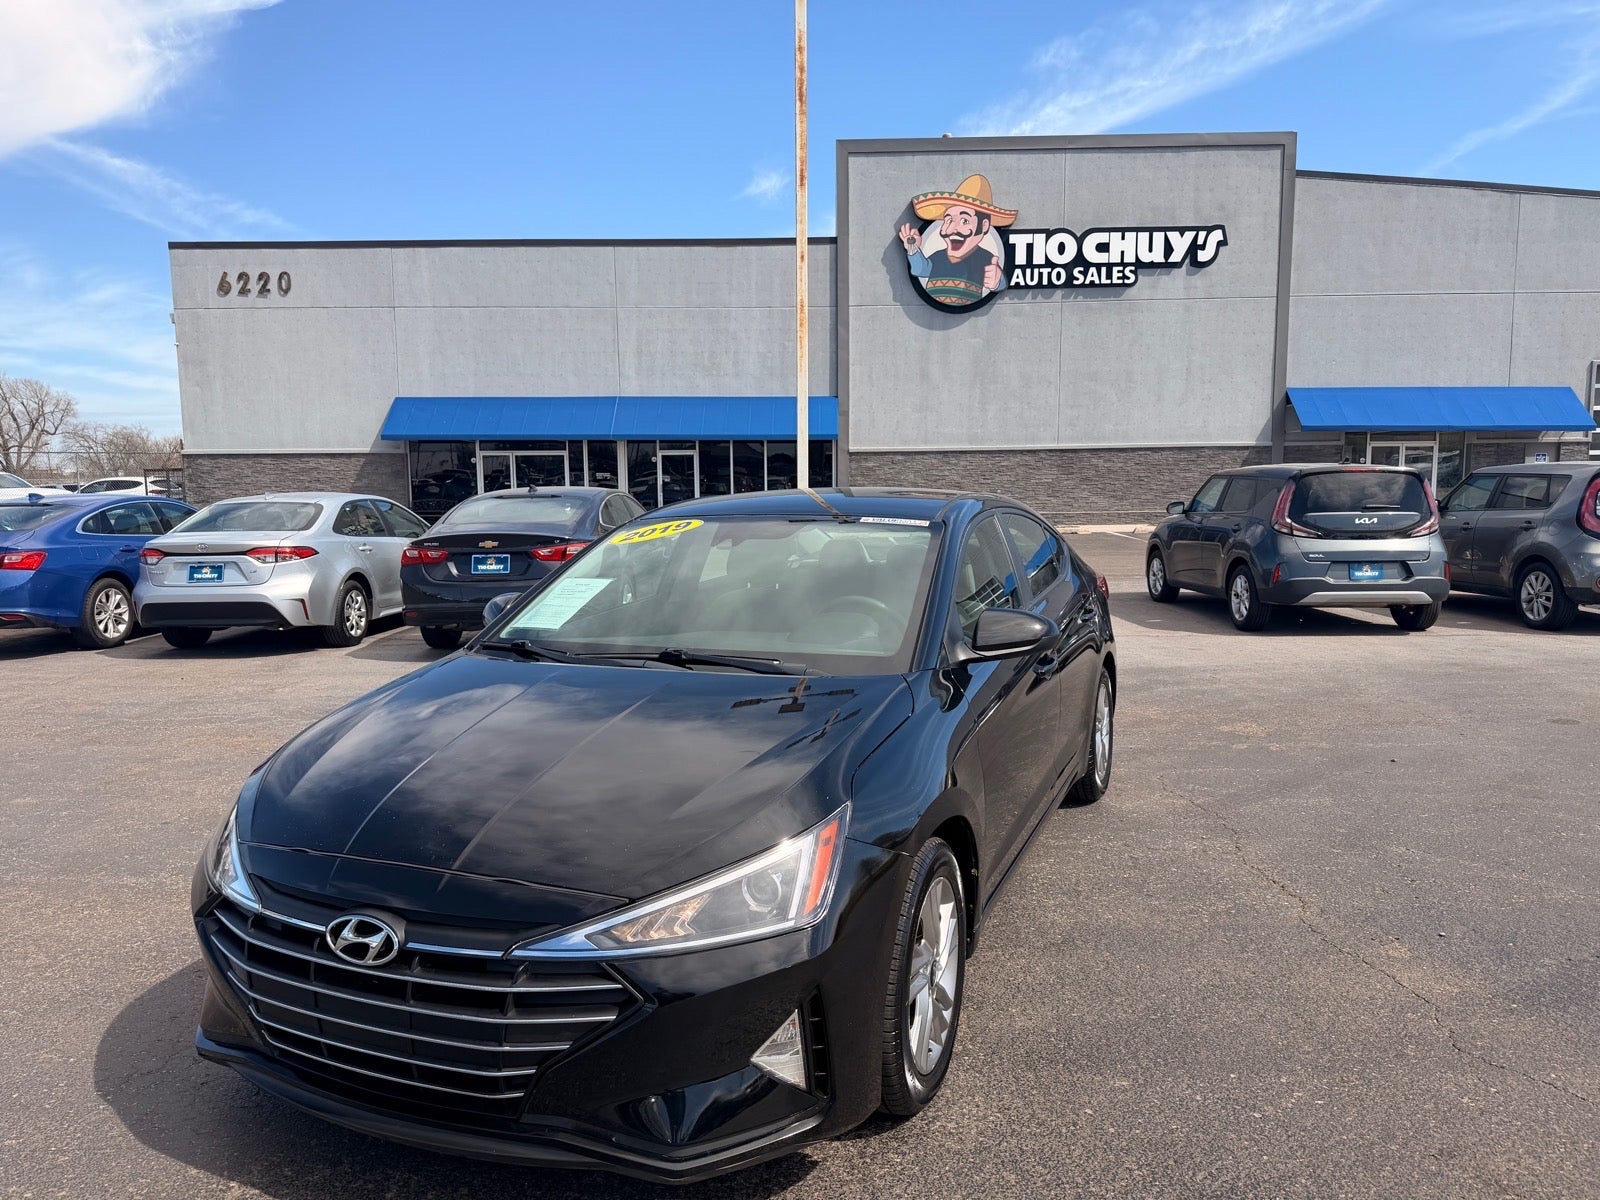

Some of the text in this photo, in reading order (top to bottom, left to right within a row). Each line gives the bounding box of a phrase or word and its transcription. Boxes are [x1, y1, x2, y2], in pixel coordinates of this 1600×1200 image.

[1009, 228, 1224, 266] TIO CHUY'S
[217, 271, 292, 296] 6220
[1010, 266, 1137, 286] AUTO SALES
[618, 521, 693, 543] 2019
